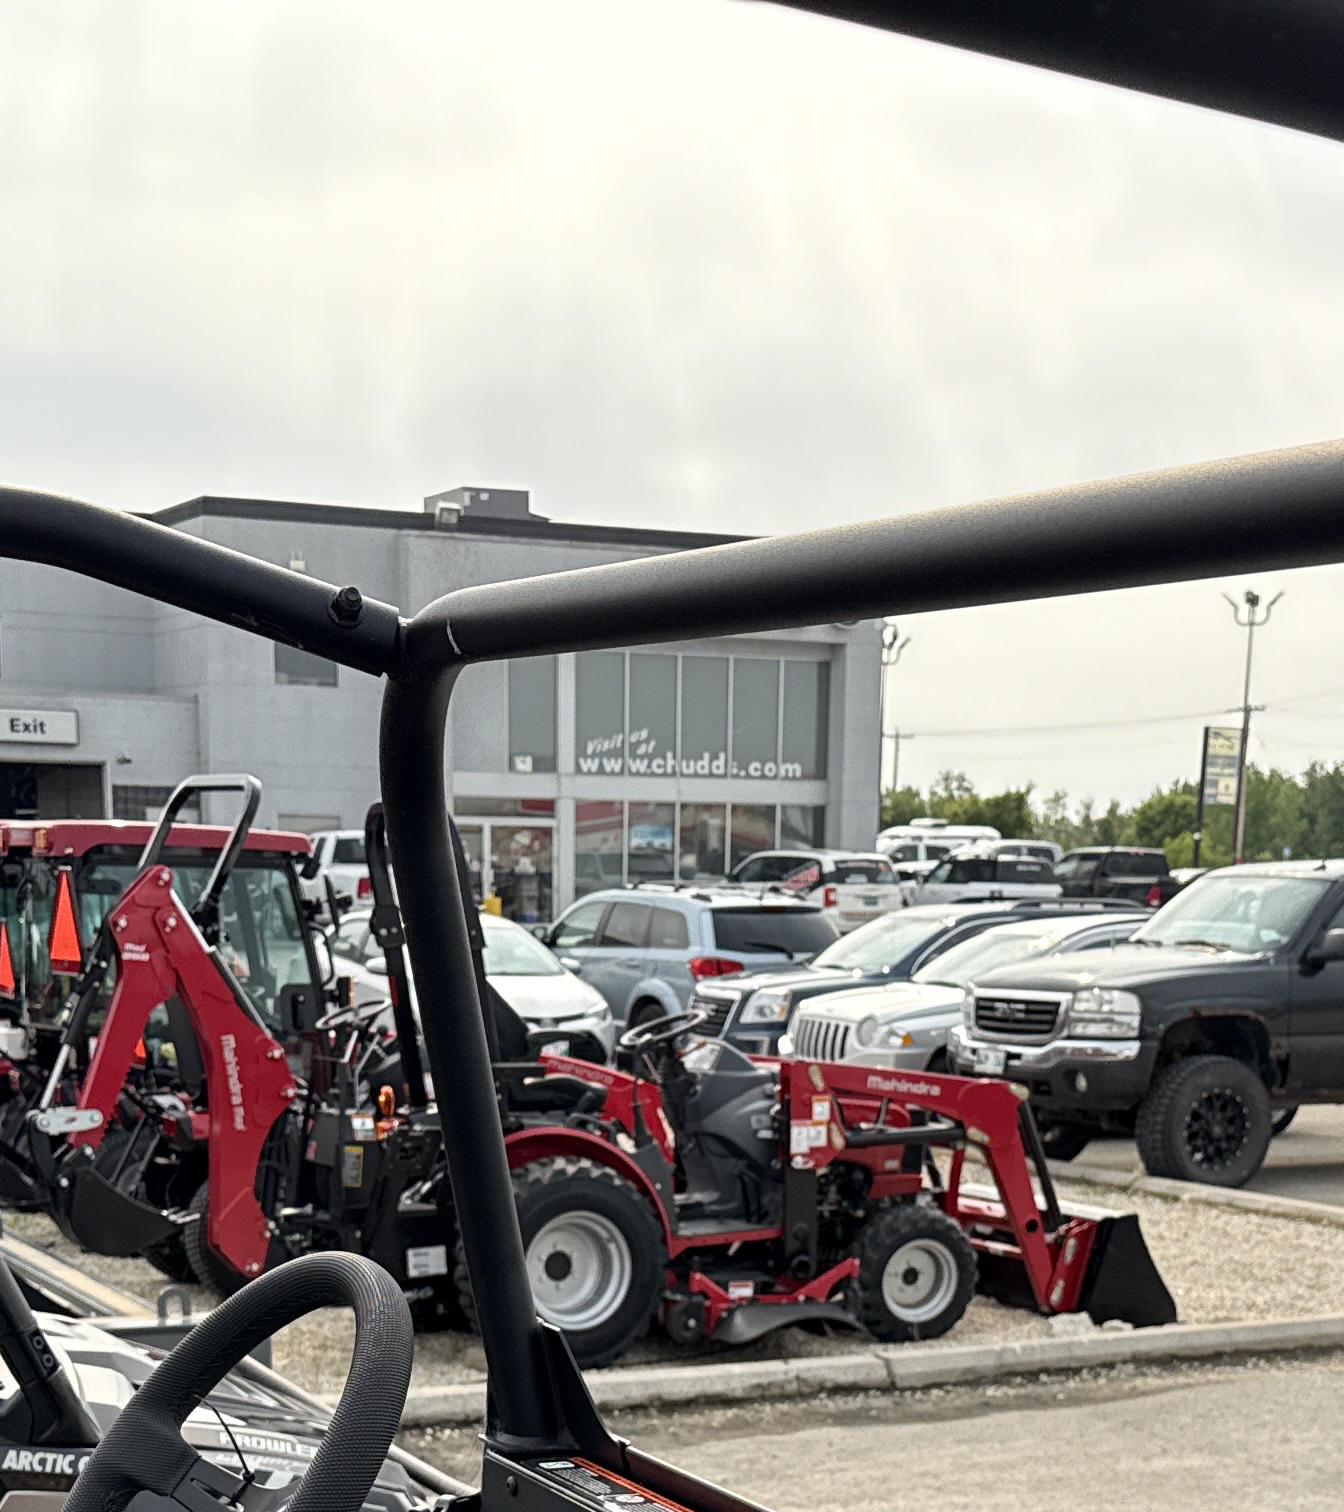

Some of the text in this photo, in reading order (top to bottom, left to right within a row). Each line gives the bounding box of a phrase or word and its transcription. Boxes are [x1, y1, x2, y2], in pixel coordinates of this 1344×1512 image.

[9, 717, 47, 736] Exit
[585, 732, 623, 755] Visit
[2, 1450, 75, 1475] ARCTIC
